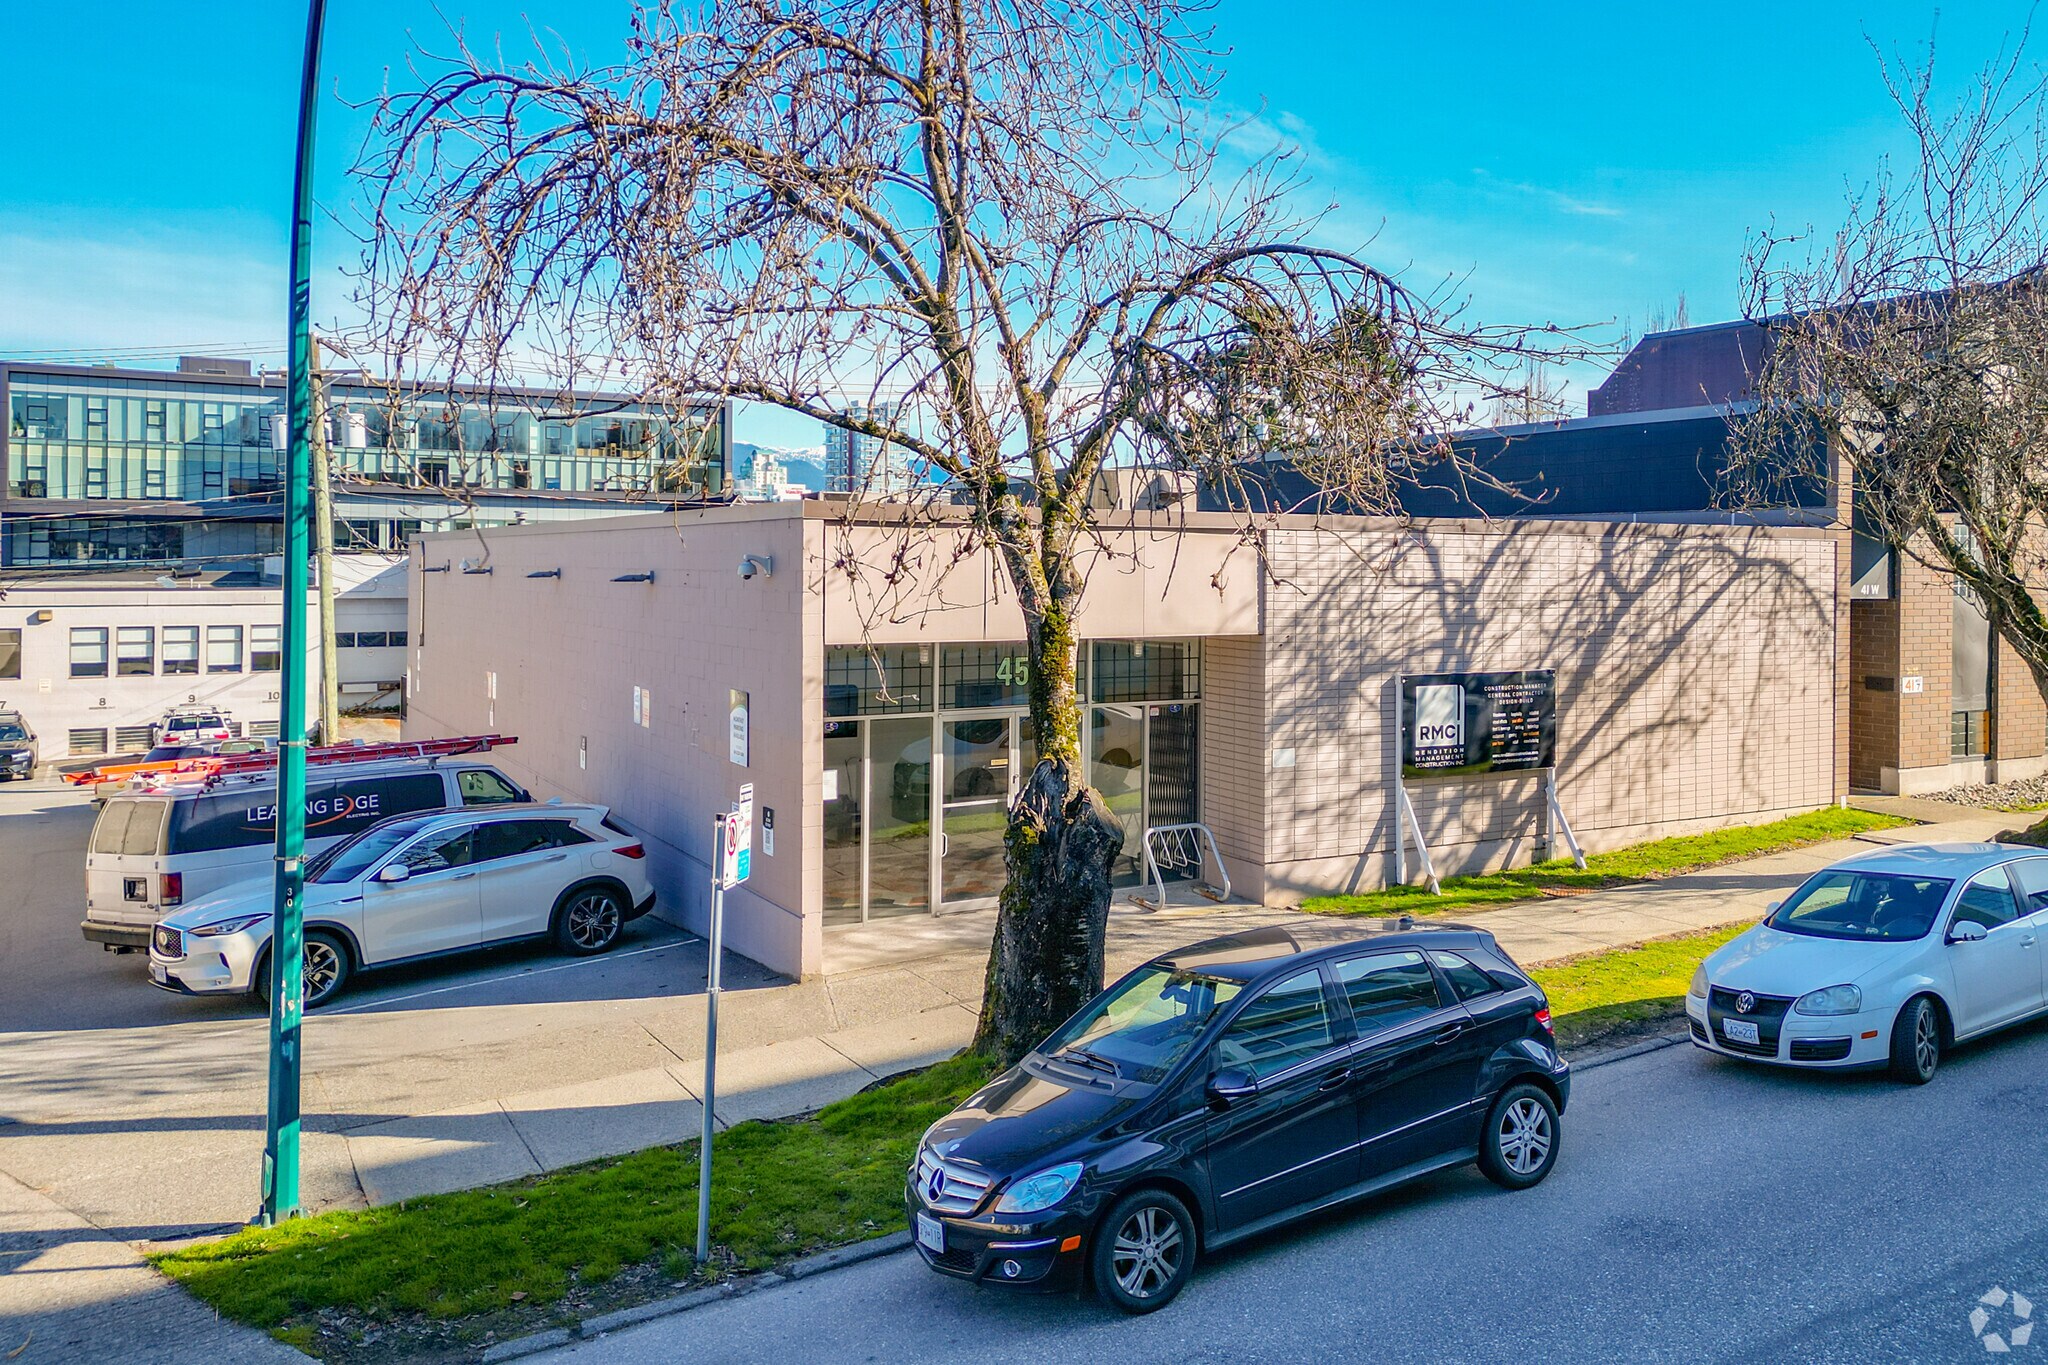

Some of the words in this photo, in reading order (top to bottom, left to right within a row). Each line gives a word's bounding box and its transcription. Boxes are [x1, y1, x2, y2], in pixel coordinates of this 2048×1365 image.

[1870, 584, 1880, 595] W
[996, 656, 1029, 686] 45
[1484, 684, 1523, 692] CONSTRUCTION
[188, 694, 196, 703] 9
[268, 691, 280, 700] 10
[99, 698, 106, 706] 8
[1419, 724, 1456, 741] RMC
[1415, 748, 1464, 756] RENDITION
[1415, 754, 1464, 762] MANAGEMENT
[1415, 761, 1455, 769] CONSTRUCTION
